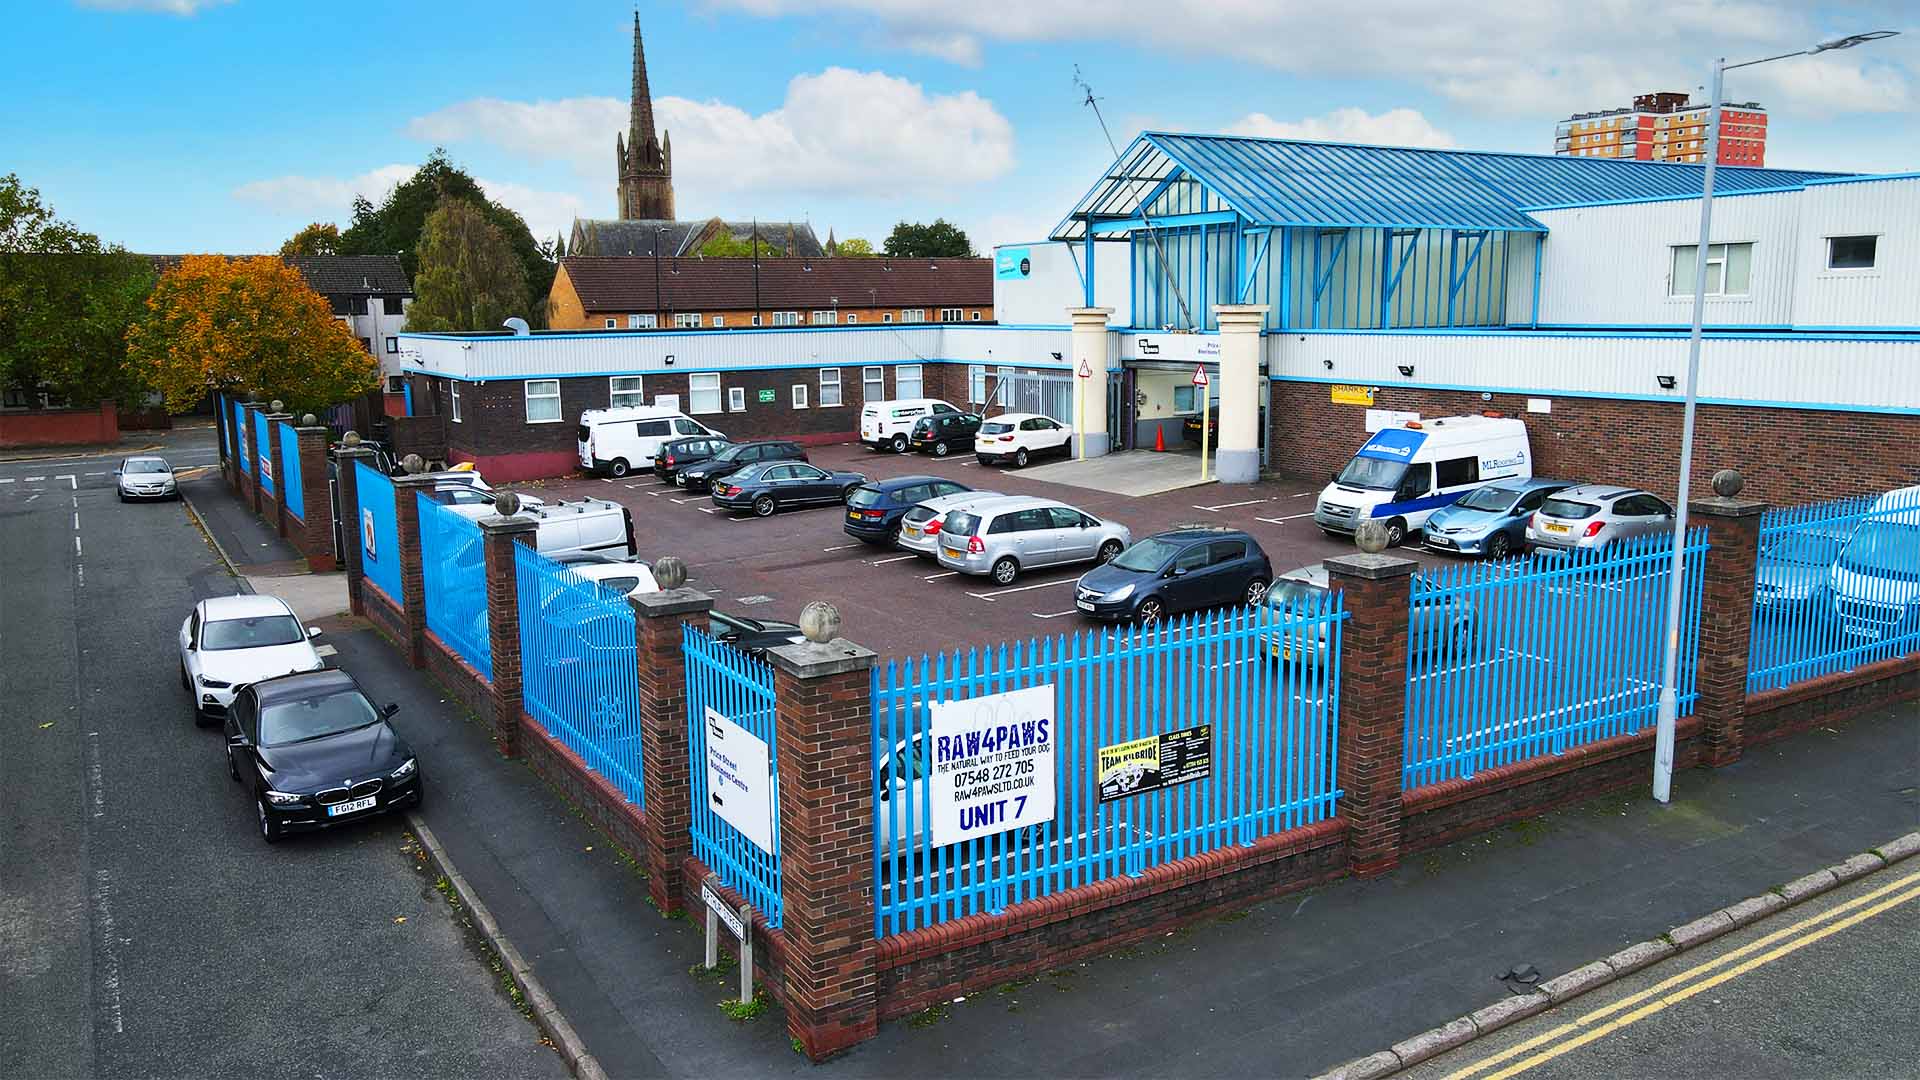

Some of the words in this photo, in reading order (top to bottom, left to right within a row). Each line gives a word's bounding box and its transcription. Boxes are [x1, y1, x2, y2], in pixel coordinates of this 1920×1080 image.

[710, 746, 722, 761] Price
[938, 719, 1049, 763] RAW4PAWS
[938, 764, 949, 774] THE
[951, 758, 978, 770] NATURAL
[980, 754, 993, 765] WAY
[995, 752, 1003, 762] TO
[1004, 749, 1020, 760] FEED
[1021, 746, 1037, 757] YOUR
[954, 768, 990, 788] 07548
[993, 763, 1012, 781] 272
[1015, 758, 1035, 776] 705
[1101, 755, 1122, 773] TEAM
[1123, 745, 1157, 762] KILBRIDE
[710, 759, 731, 781] Business
[731, 775, 749, 793] Centre
[954, 775, 1035, 802] RAW4PAWSLTD.CO.UK
[335, 803, 355, 813] FG12
[356, 800, 372, 808] RFL
[960, 799, 1008, 831] UNIT
[1014, 795, 1028, 819] 7
